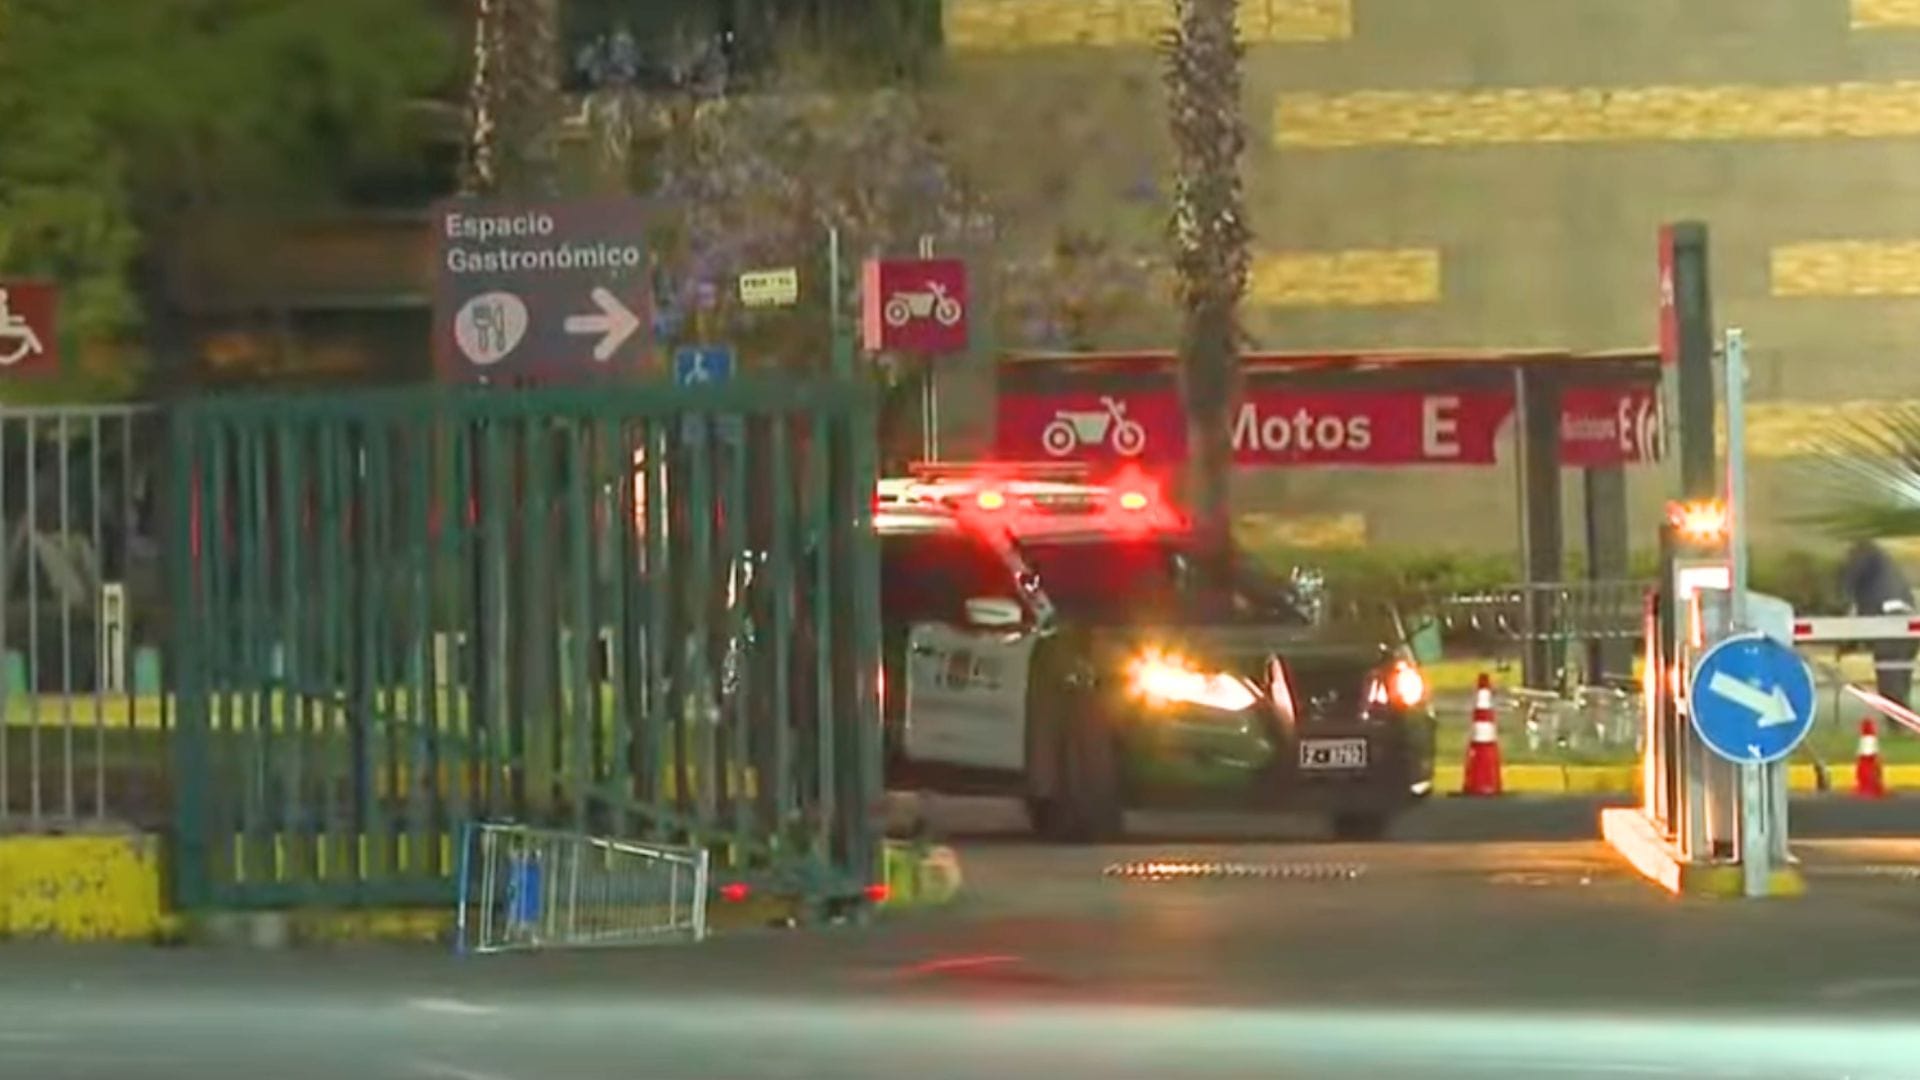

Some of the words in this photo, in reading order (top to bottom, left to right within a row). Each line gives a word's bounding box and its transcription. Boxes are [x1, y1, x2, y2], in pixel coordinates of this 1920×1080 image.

[446, 212, 554, 242] Espacio
[447, 243, 640, 273] Gastronómico
[1422, 396, 1461, 456] E
